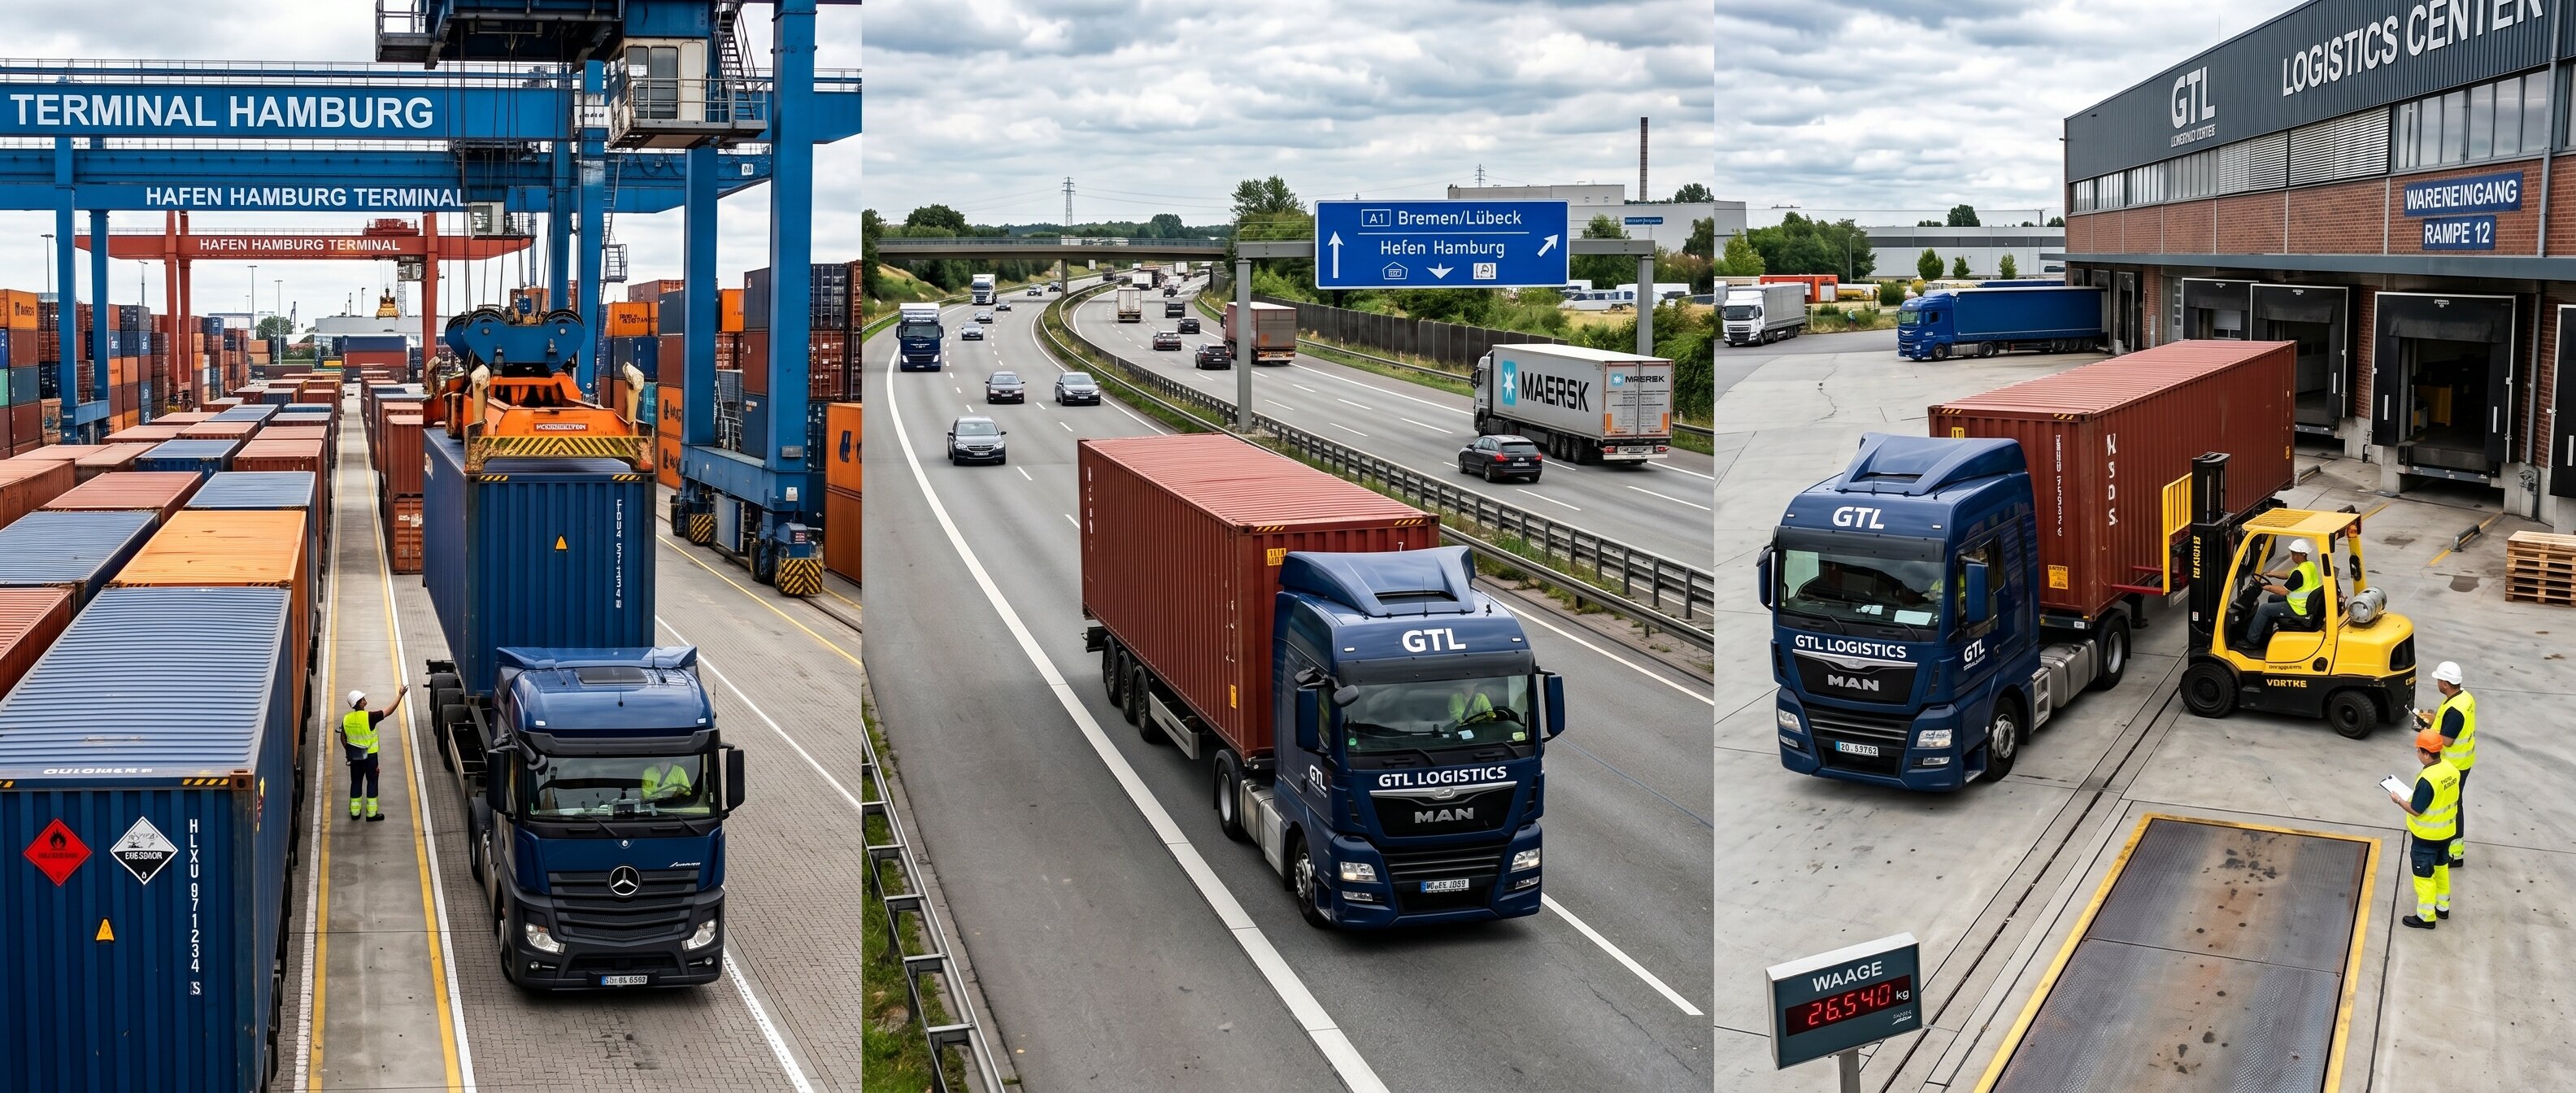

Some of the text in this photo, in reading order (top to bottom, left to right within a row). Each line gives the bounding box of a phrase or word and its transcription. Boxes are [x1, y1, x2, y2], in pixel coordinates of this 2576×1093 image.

[2283, 15, 2398, 97] LOGISTICS
[2171, 67, 2215, 129] GTL
[10, 94, 433, 128] TERMINAL HAMBURG
[146, 187, 465, 207] HAFEN HAMBURG TERMINAL
[2406, 179, 2517, 210] WARENEINGANG
[1369, 210, 1521, 225] A1 Bremen/Lübeck
[200, 239, 401, 250] HAFEN HAMBURG TERMINAL
[2425, 221, 2491, 244] RAMPE 12
[1434, 239, 1504, 259] Hamburg
[1521, 371, 1590, 413] MAERSK
[1832, 506, 1885, 529] GTL
[1402, 628, 1466, 652] GTL
[1795, 634, 1907, 659] GTL LOGISTICS
[1964, 638, 1985, 662] GTL
[1827, 674, 1879, 691] MAN
[1309, 764, 1327, 791] GTL
[1378, 766, 1508, 787] GTL LOGISTICS
[1414, 807, 1474, 824] MAN
[189, 818, 199, 878] HLXU
[1812, 960, 1882, 992] WAAGE
[1808, 984, 1891, 1026] 26.540
[1896, 989, 1909, 1000] kg
